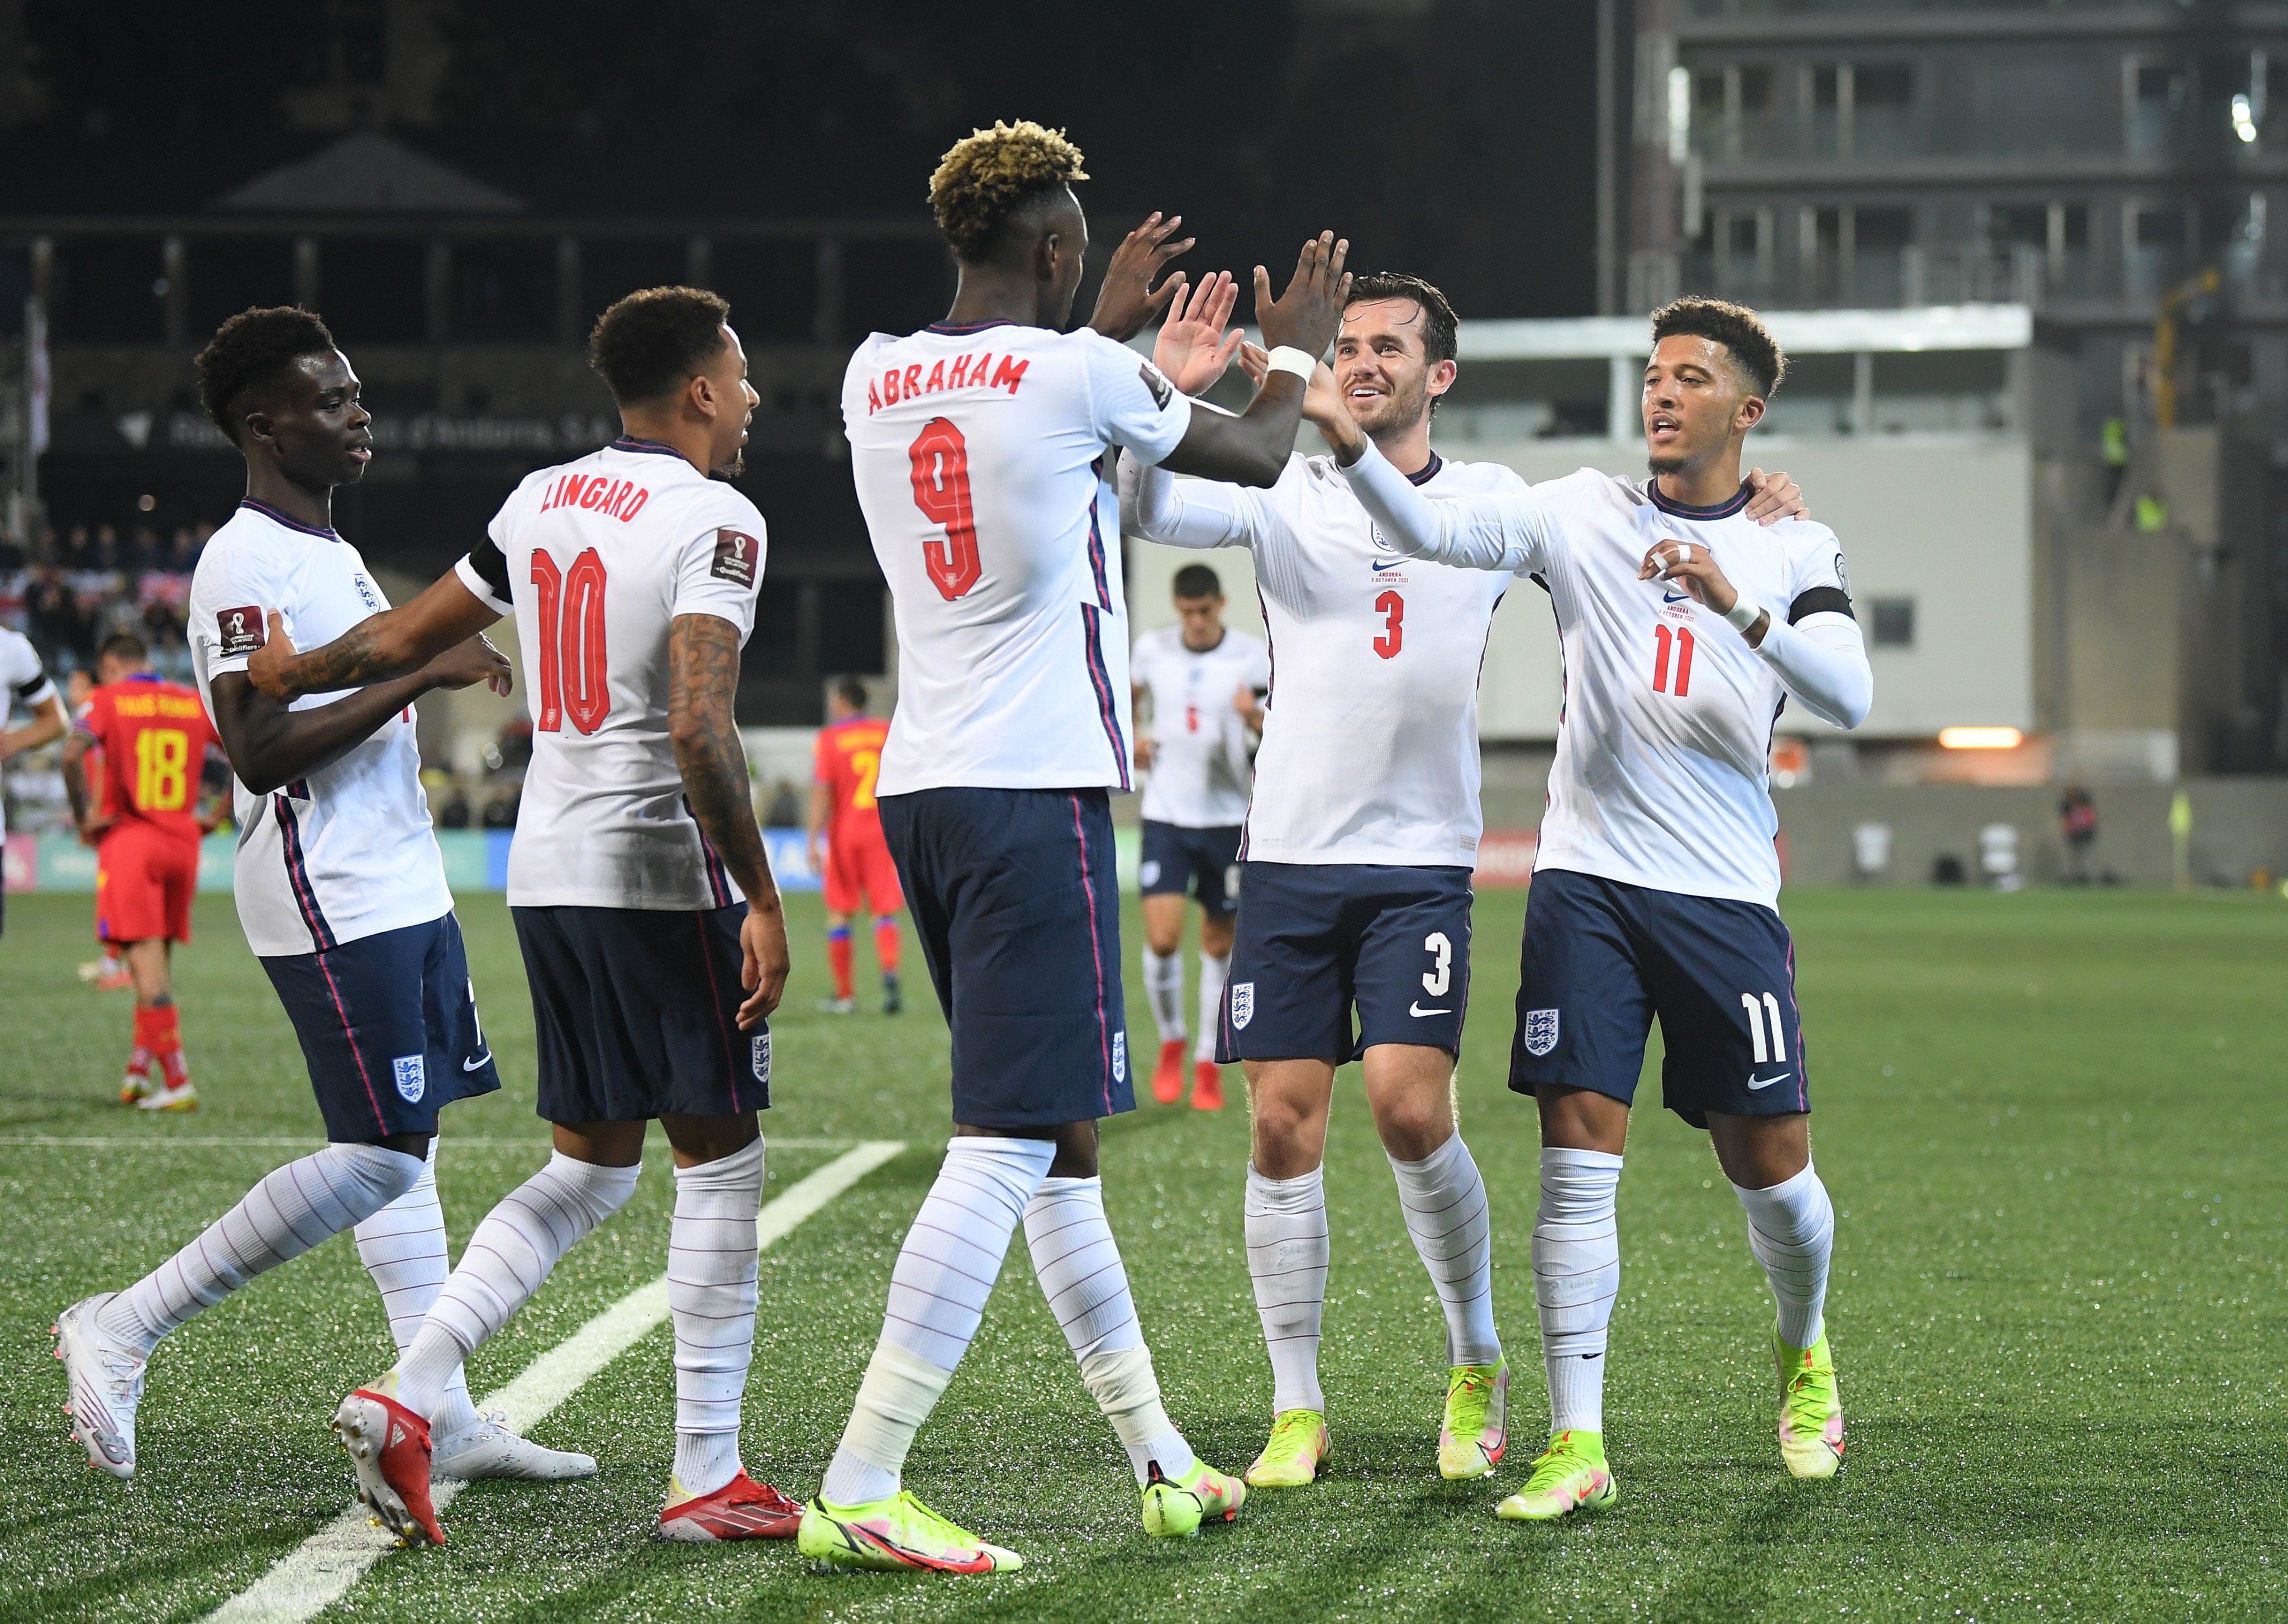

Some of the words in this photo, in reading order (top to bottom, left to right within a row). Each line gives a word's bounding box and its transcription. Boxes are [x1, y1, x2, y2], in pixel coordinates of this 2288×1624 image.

[869, 353, 1030, 416] ABRAHAM
[540, 474, 649, 522] LINGARD
[909, 417, 982, 602] 9
[531, 547, 611, 735] 10
[1374, 590, 1404, 659] 3
[1662, 610, 1683, 619] OCTOBER
[1666, 605, 1689, 615] ANDORRA
[1653, 624, 1695, 697] 11
[136, 728, 188, 810] 18
[851, 750, 880, 809] 2
[1422, 931, 1452, 997] 3
[1741, 992, 1786, 1064] 11
